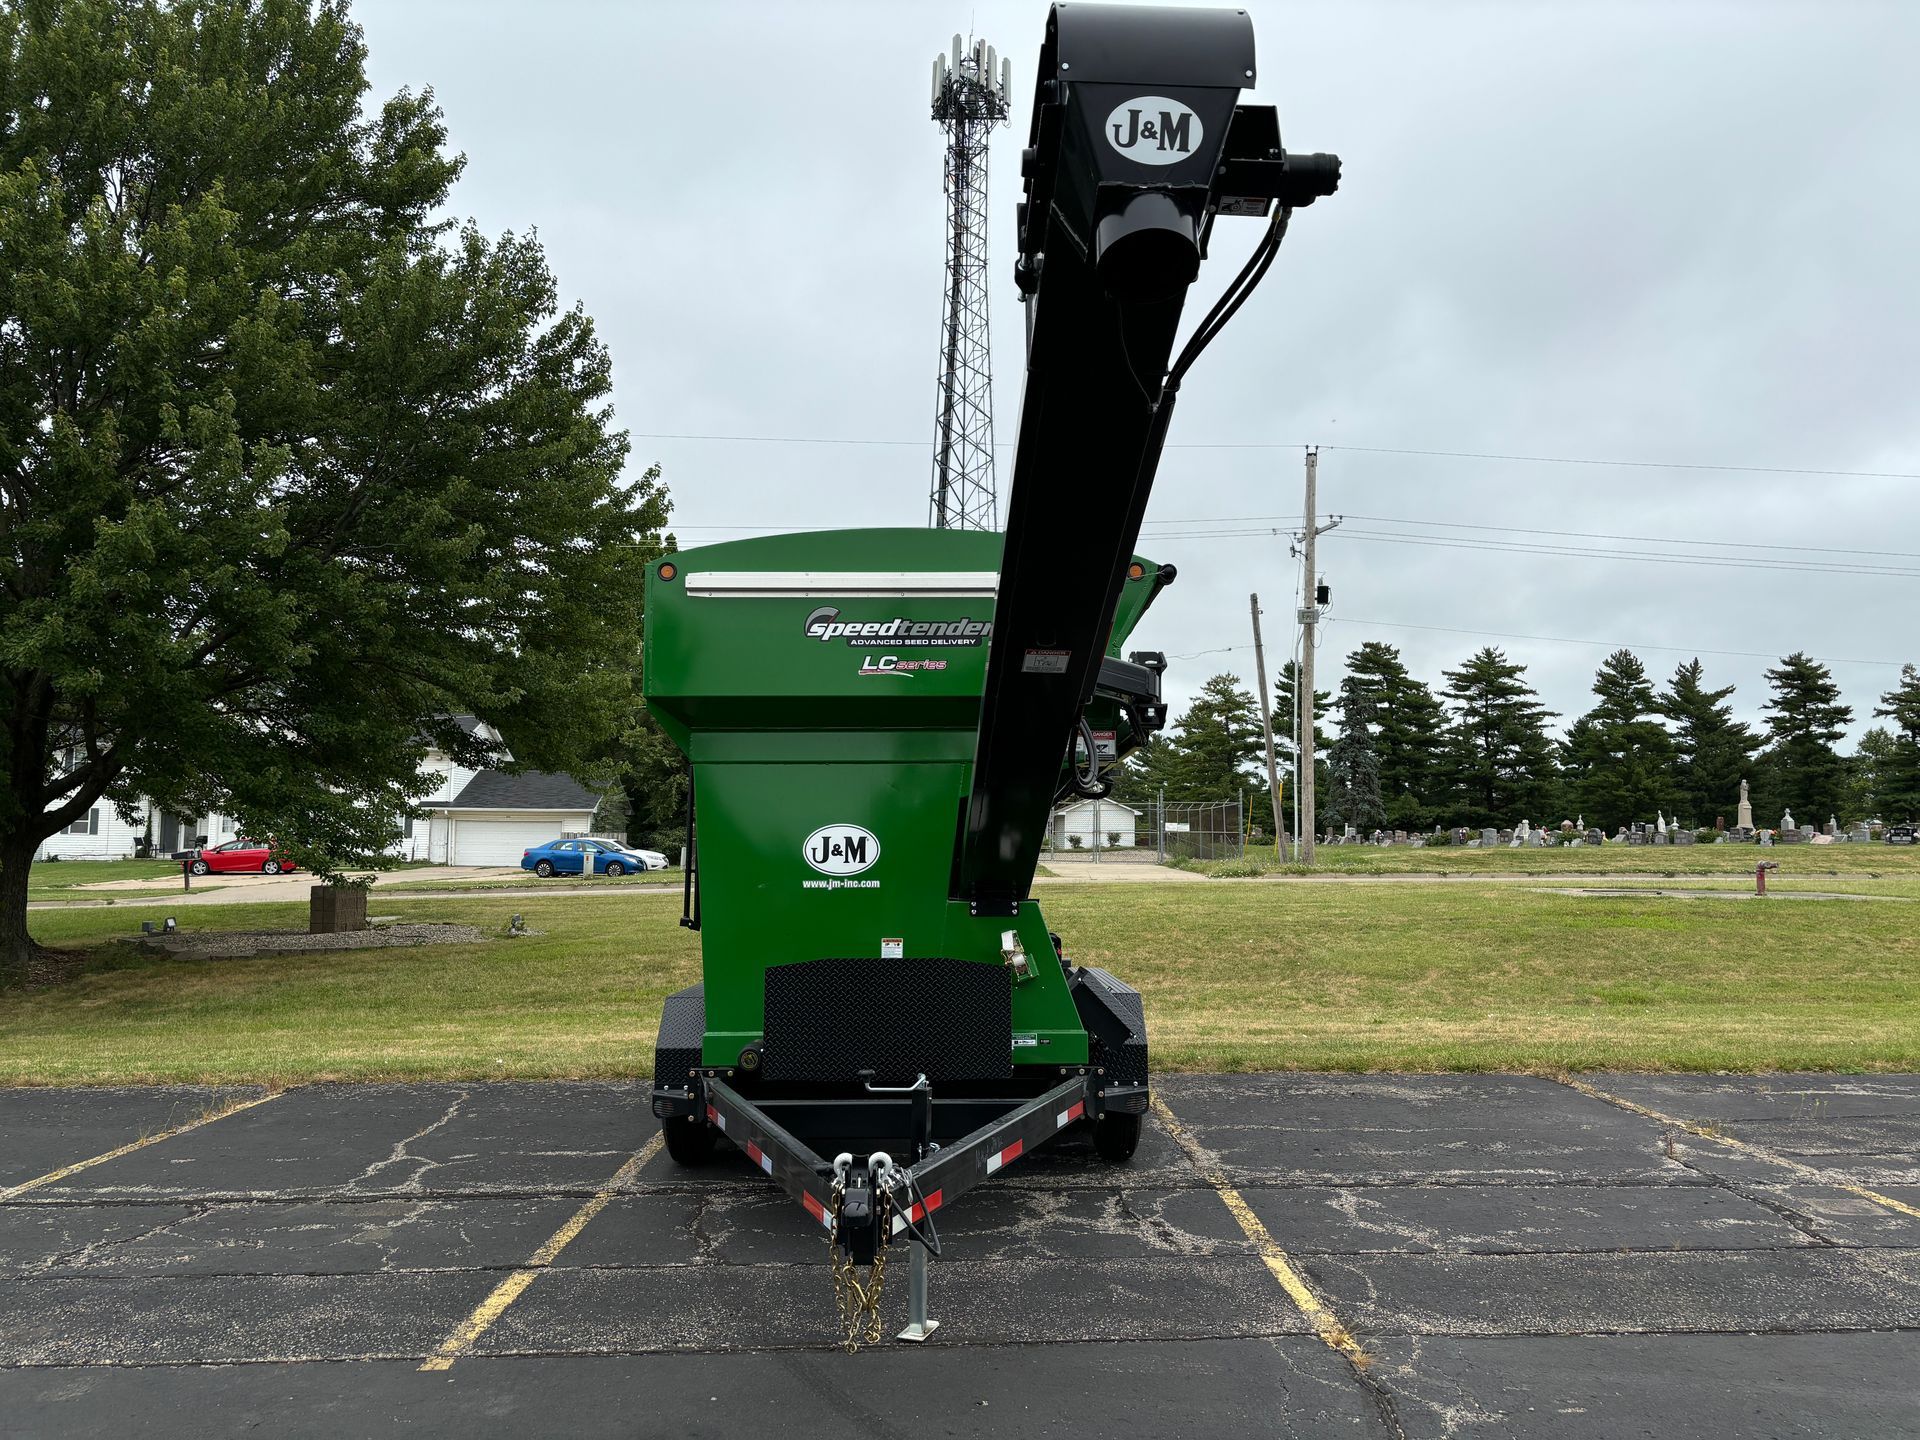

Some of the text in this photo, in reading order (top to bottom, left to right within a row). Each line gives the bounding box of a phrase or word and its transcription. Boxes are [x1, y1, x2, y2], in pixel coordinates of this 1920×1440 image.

[1112, 109, 1193, 153] J&M
[811, 836, 868, 864] J&M
[802, 879, 881, 890] www.jm-inc.com
